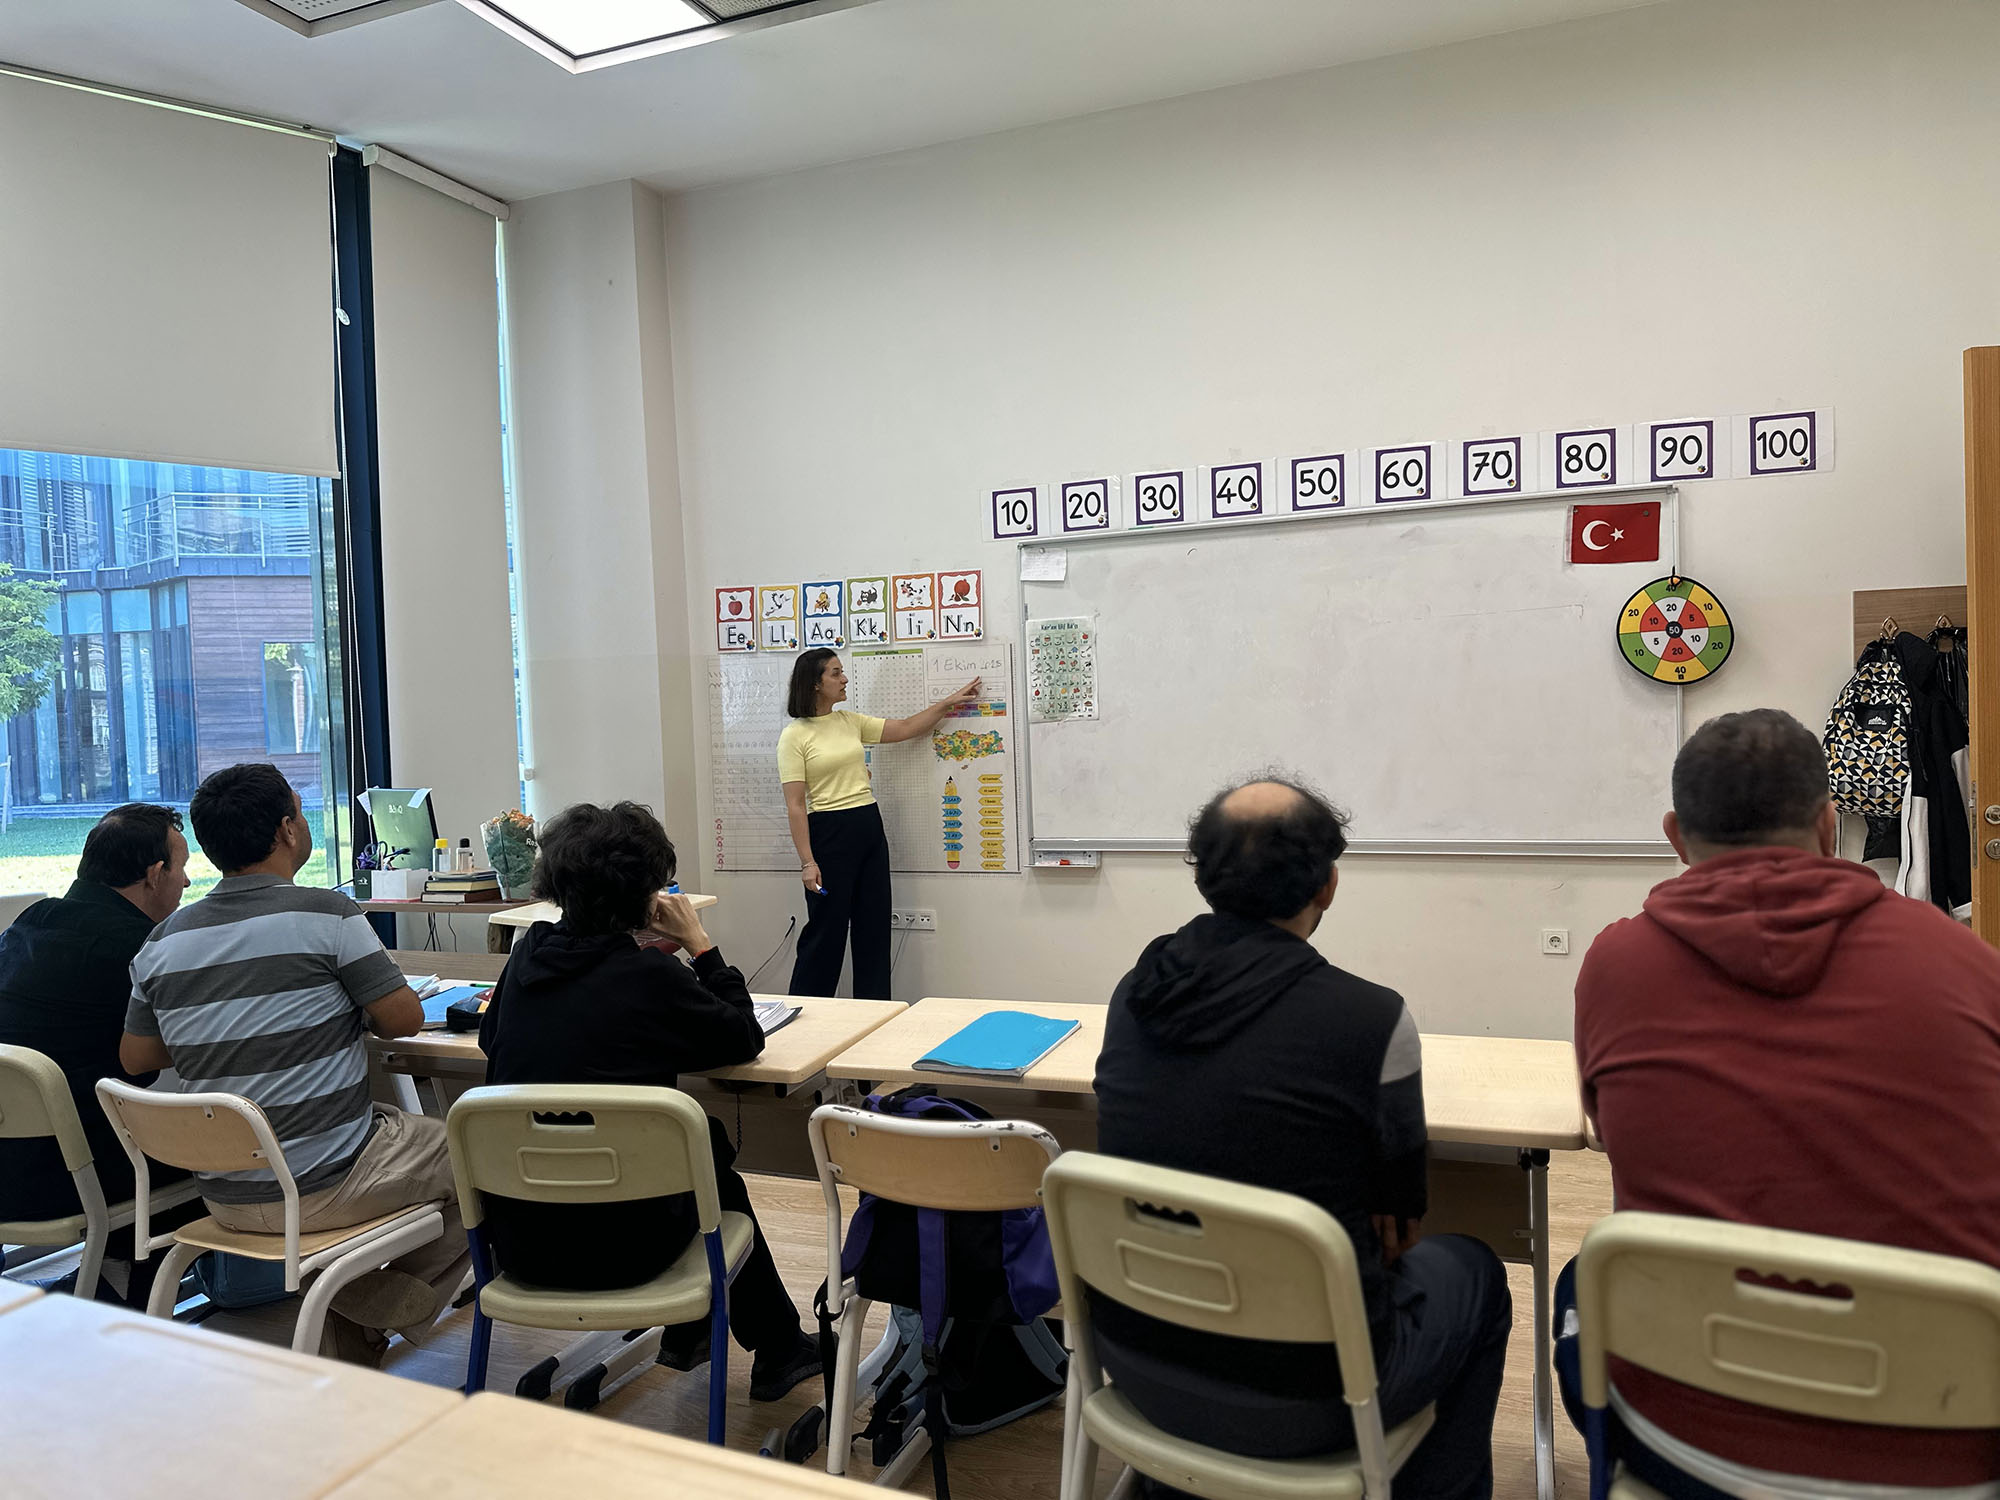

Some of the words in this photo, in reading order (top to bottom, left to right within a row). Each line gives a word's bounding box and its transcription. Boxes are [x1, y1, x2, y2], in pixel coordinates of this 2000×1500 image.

[1660, 434, 1703, 468] 90
[1756, 428, 1808, 460] 100
[1472, 450, 1513, 482] 70
[1564, 442, 1607, 474] 80
[1299, 467, 1337, 497] 50
[1382, 458, 1423, 489] 60
[1141, 483, 1177, 512] 30
[1215, 475, 1257, 504] 40
[1001, 499, 1028, 525] 10
[1068, 491, 1101, 520] 20
[1628, 608, 1639, 617] 20
[1666, 603, 1677, 612] 20
[1703, 603, 1713, 611] 10
[856, 617, 878, 636] Kk
[945, 614, 975, 634] Nn
[1649, 617, 1659, 625] 10
[1689, 614, 1695, 622] 5
[728, 626, 746, 644] Ee
[771, 625, 787, 643] Ll
[811, 622, 834, 640] Aa
[1668, 626, 1680, 634] 50
[1691, 634, 1701, 643] 10
[1635, 648, 1644, 656] 10
[1671, 647, 1683, 655] 20
[1711, 641, 1724, 650] 20
[933, 659, 938, 672] 1
[944, 658, 976, 671] Ekim
[1674, 666, 1686, 674] 40
